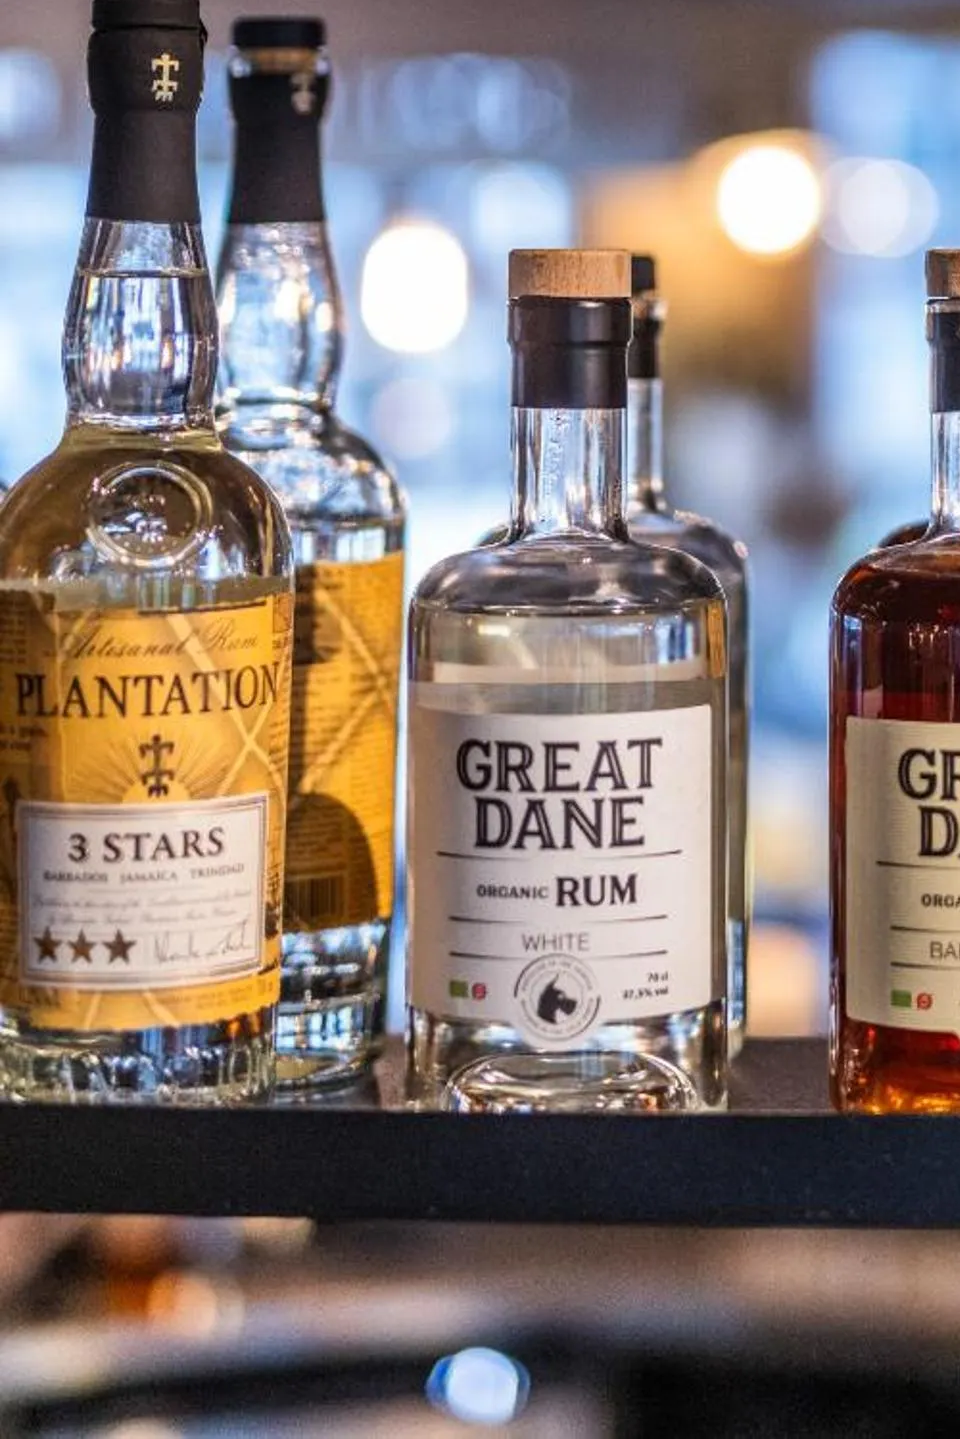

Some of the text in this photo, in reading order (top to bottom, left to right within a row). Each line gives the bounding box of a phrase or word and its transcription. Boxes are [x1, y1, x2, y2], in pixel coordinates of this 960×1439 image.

[14, 661, 280, 719] PLANTATION
[455, 737, 664, 793] GREAT
[473, 796, 646, 851] DANE
[67, 826, 225, 863] 3 STARS
[43, 862, 245, 885] BARBADOS JAMAICA TRINIDAD
[476, 873, 638, 908] ORGANIC RUM
[521, 931, 590, 953] WHITE
